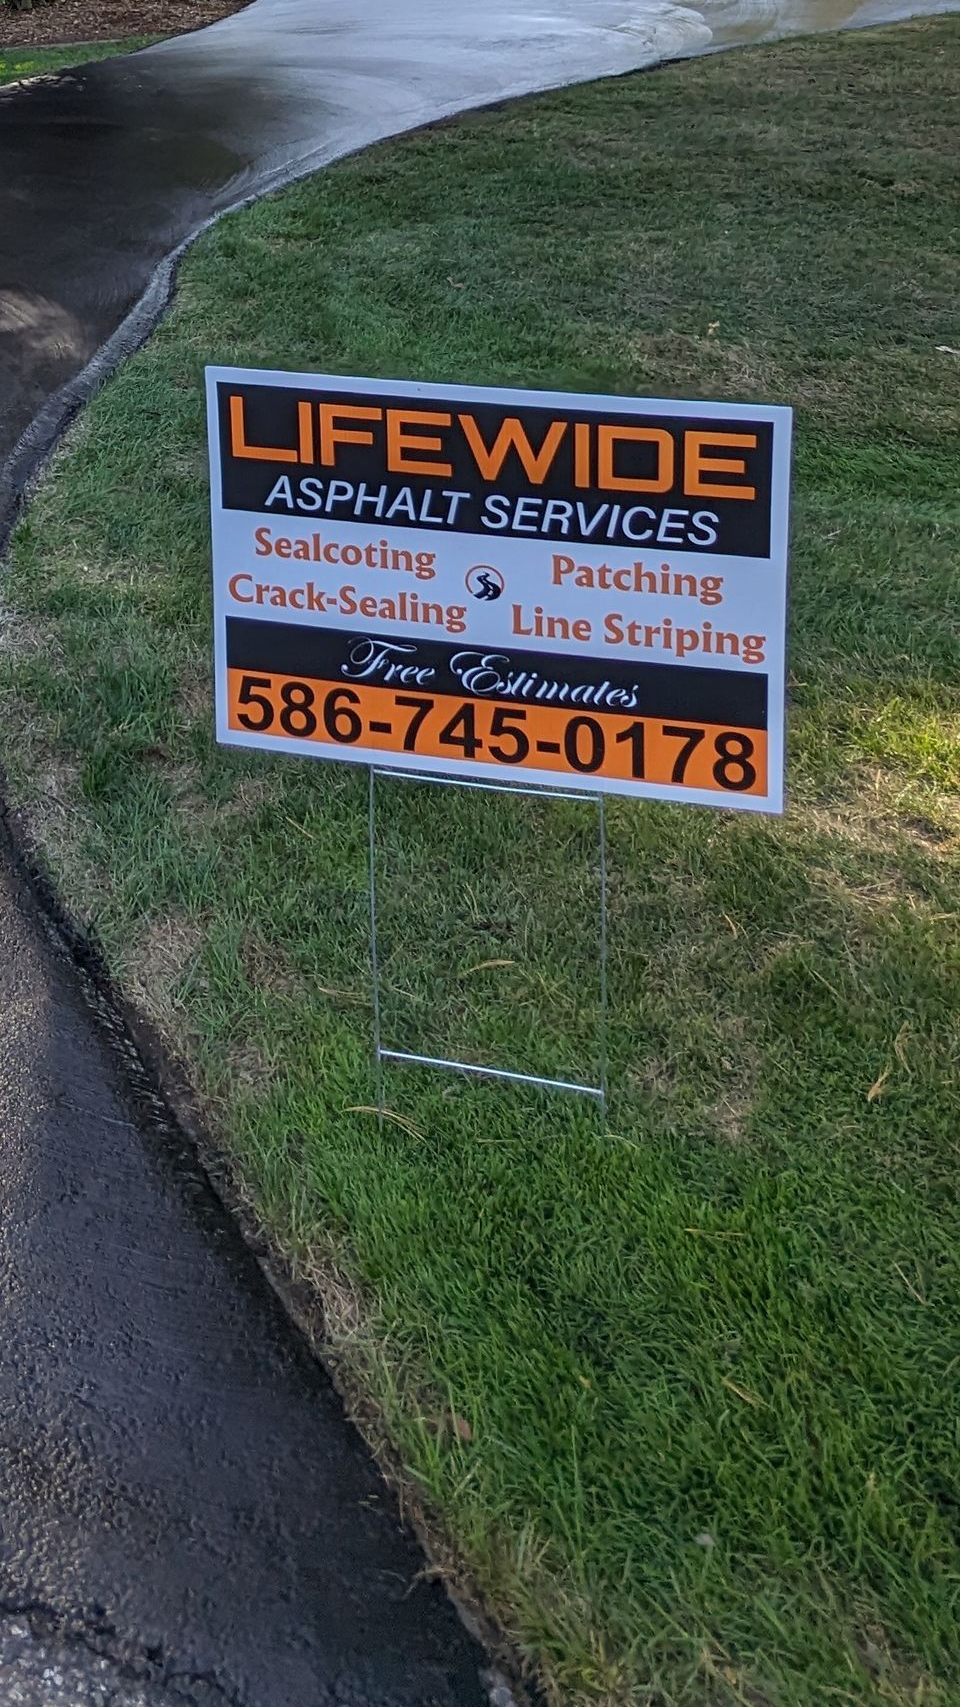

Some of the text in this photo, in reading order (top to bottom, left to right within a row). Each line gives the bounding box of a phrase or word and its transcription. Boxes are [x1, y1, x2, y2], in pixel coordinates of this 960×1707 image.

[229, 395, 757, 500] LIFEWIDE
[264, 475, 720, 546] ASPHALT SERVICES
[254, 527, 437, 580] Sealcoting
[551, 554, 724, 606] Patching
[228, 574, 467, 634] Crack-Sealing
[512, 605, 766, 664] Line Striping
[341, 638, 639, 708] Free Estimates
[236, 677, 757, 791] 586-745-0178
